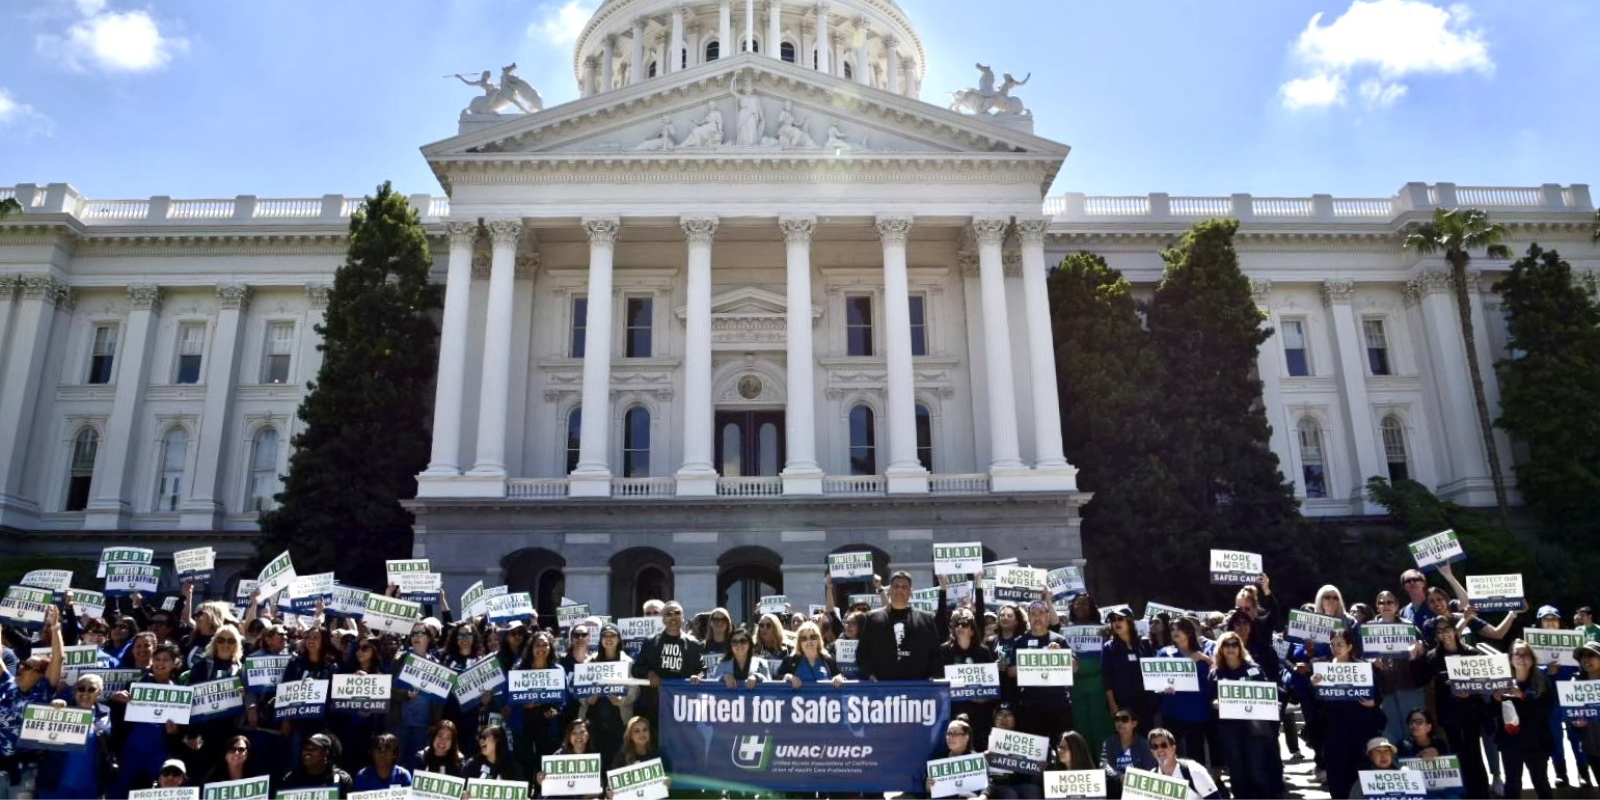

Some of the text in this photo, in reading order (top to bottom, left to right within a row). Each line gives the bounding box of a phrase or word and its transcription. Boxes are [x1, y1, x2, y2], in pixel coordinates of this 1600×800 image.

[937, 547, 979, 558] READY
[1430, 541, 1458, 555] STAFFING
[104, 550, 150, 561] READY
[1224, 554, 1250, 562] MORE
[114, 566, 154, 576] UNITED FOR
[389, 563, 428, 571] READY
[1216, 560, 1258, 571] NURSES
[1008, 569, 1036, 578] MORE
[127, 576, 158, 584] STAFFING
[1001, 576, 1042, 587] NURSES
[31, 591, 45, 602] FOR
[18, 602, 47, 613] STAFFING
[370, 598, 416, 618] READY
[1296, 613, 1335, 627] UNITED FOR
[1291, 622, 1331, 636] SAFE STAFFI
[1528, 634, 1581, 646] READY
[253, 660, 276, 669] UNITED
[660, 656, 682, 670] HUG
[1020, 654, 1068, 665] READY
[1460, 658, 1493, 668] MORE
[587, 664, 615, 672] MORE
[958, 666, 986, 675] MORE
[1144, 662, 1192, 672] READY
[1327, 666, 1358, 674] MORE
[1454, 667, 1504, 676] NURSES
[346, 677, 377, 686] MORE
[404, 666, 450, 690] SAFE STAFFING
[457, 670, 501, 697] SAFE STAFFING
[514, 679, 560, 688] NURSES
[1320, 674, 1367, 683] NURSES
[220, 681, 234, 692] FOR
[286, 684, 314, 692] MORE
[338, 686, 385, 695] NURSES
[1455, 681, 1508, 690] SAFER CARE
[1574, 684, 1600, 693] MOR
[133, 688, 190, 703] READY
[193, 690, 240, 706] AFE STAFFING
[278, 691, 320, 702] NURSES
[1222, 686, 1273, 699] READY
[276, 706, 320, 718] SAFER CARE
[674, 692, 937, 726] United for Safe Staffing
[1566, 709, 1598, 717] SAFER
[33, 708, 83, 723] UNITED FOR
[26, 721, 86, 734] SAFE STAFFING
[1005, 733, 1035, 747] MORE
[775, 744, 873, 758] UNAC/UHCP
[995, 741, 1042, 757] NURSES
[546, 760, 596, 774] READY
[932, 758, 982, 776] READY
[1436, 759, 1451, 769] FOR
[612, 765, 660, 788] READY
[1059, 774, 1091, 784] MORE
[1423, 770, 1458, 780] STAFFING
[208, 782, 264, 800] READY
[414, 775, 462, 796] READY
[1051, 783, 1100, 794] NURSES
[1128, 774, 1184, 798] READY
[1368, 782, 1419, 790] NURSES
[134, 790, 174, 799] PROTECT
[352, 792, 388, 800] PROTECT
[469, 785, 527, 800] READY
